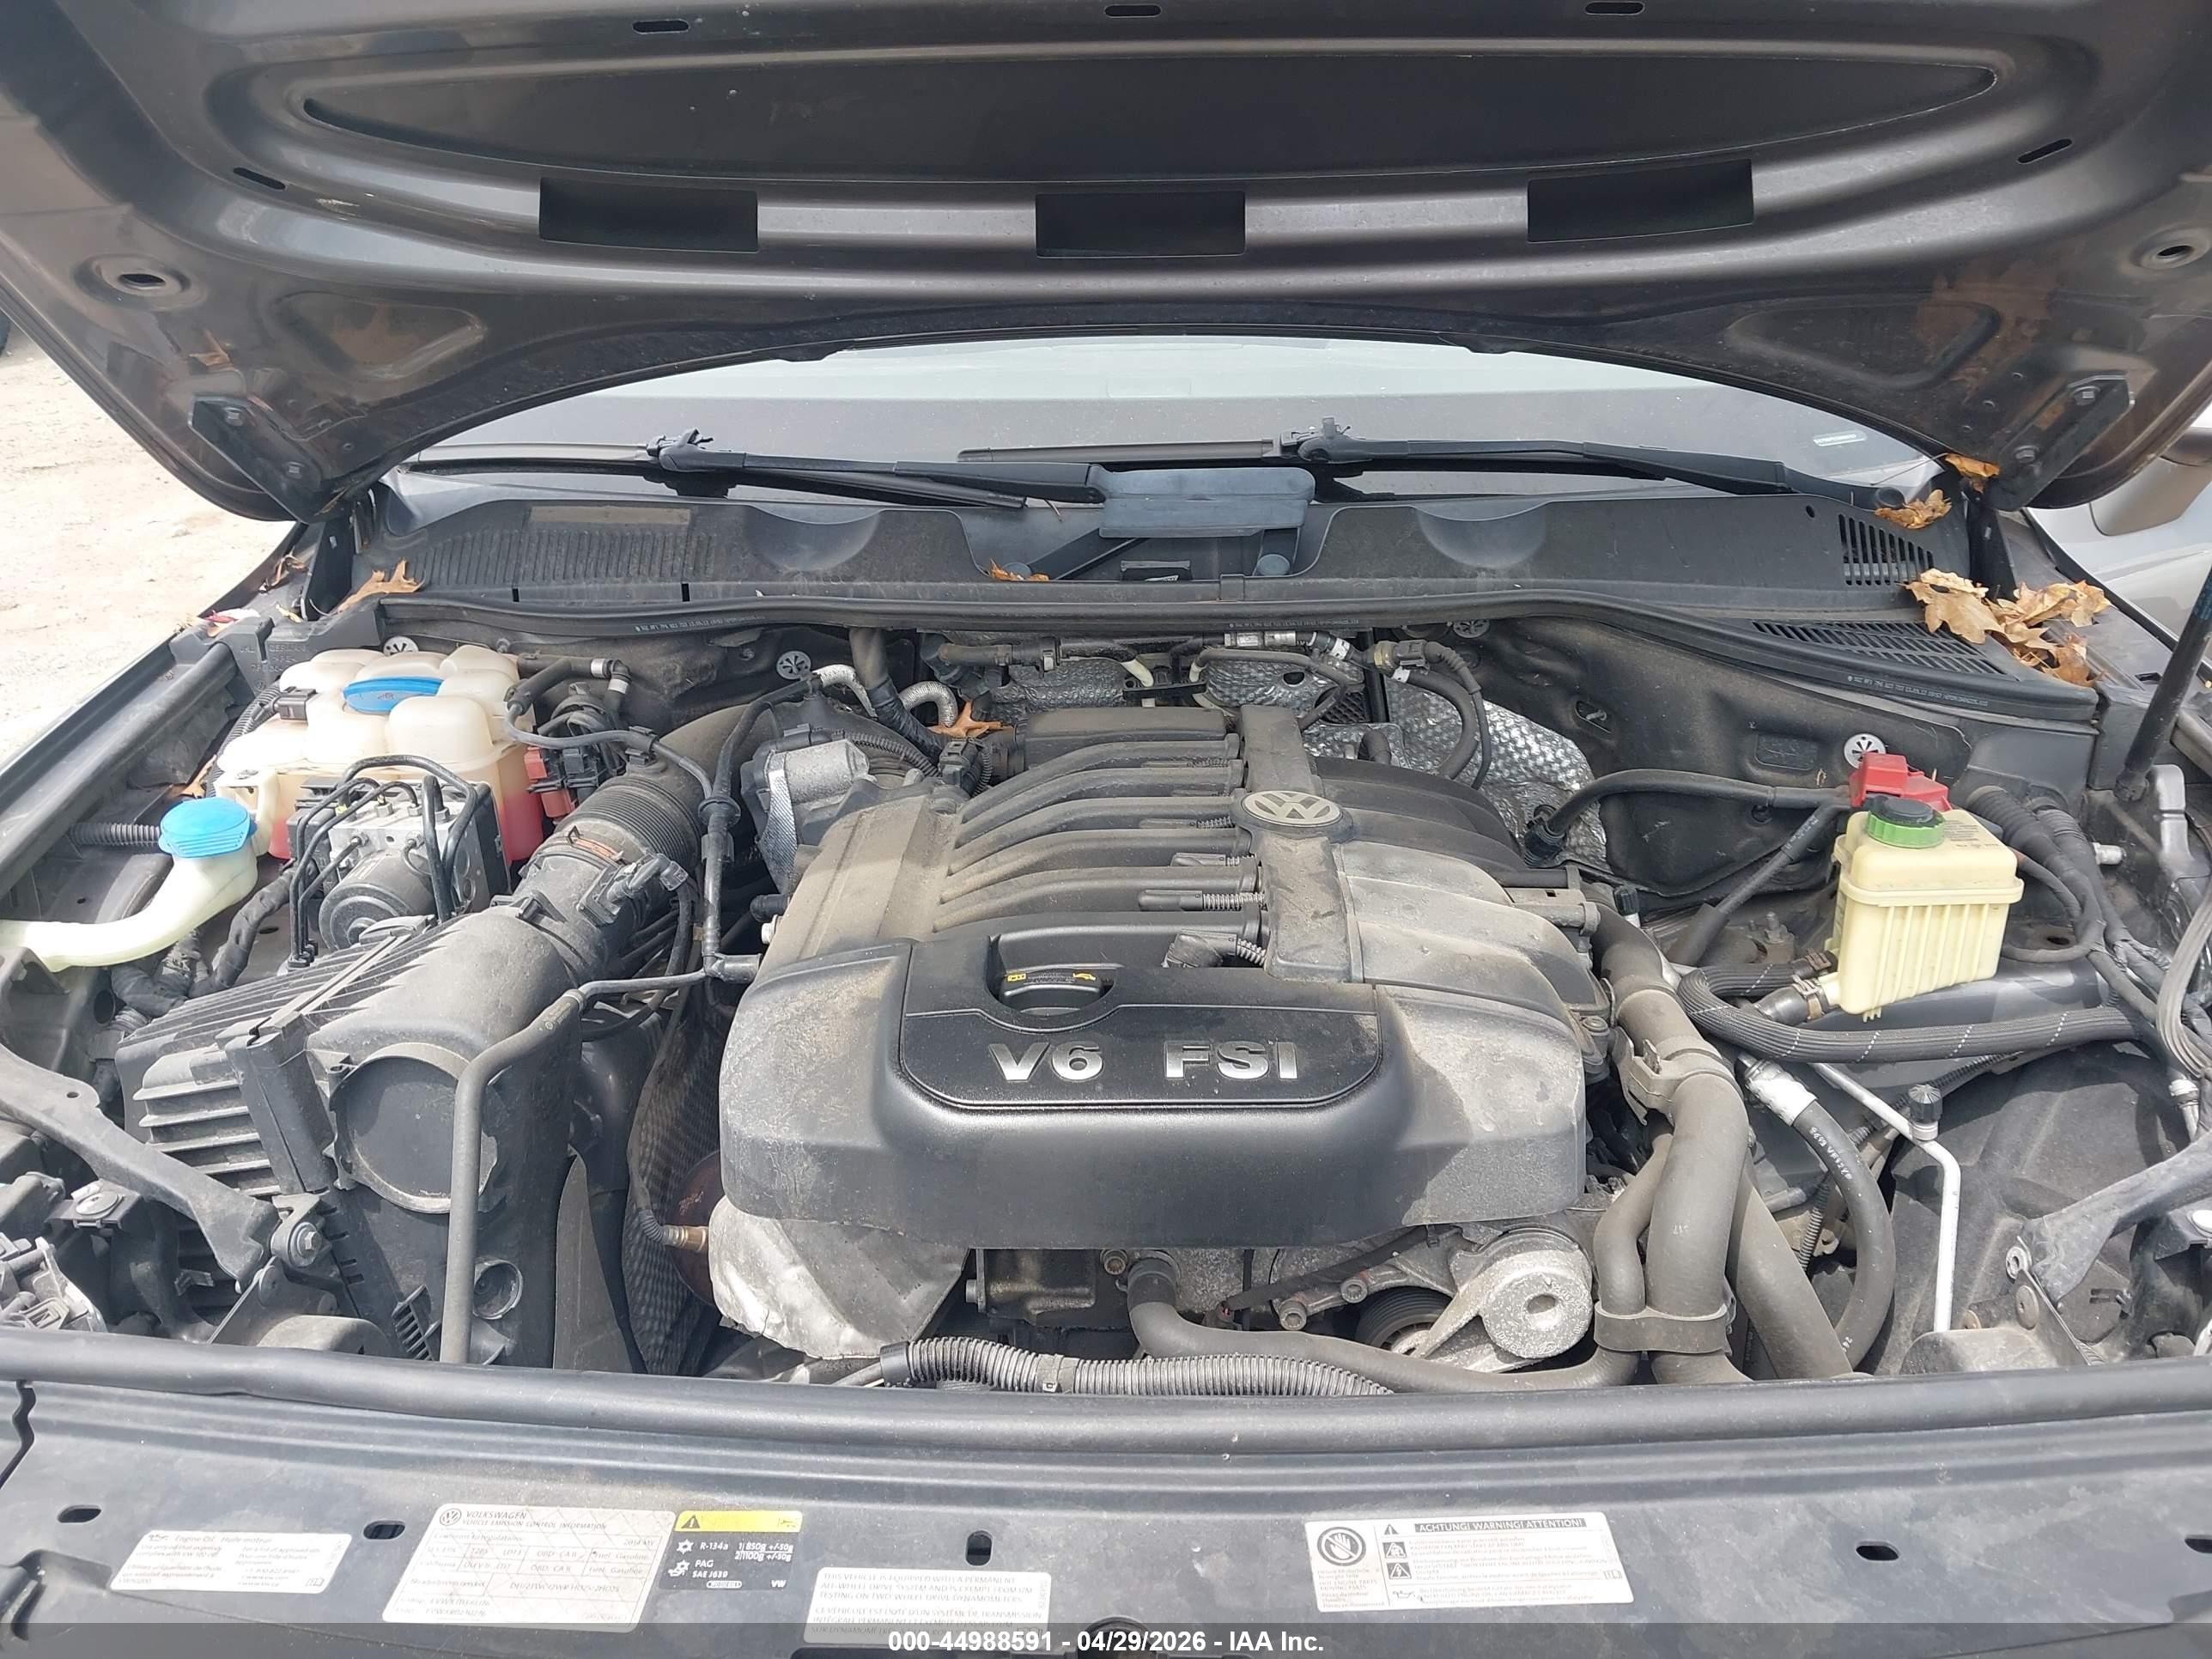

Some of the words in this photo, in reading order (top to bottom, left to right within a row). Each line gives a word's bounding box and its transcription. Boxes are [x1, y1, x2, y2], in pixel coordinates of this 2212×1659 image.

[988, 1041, 1104, 1081] V6
[1164, 1040, 1298, 1080] FSI
[465, 1510, 527, 1520] VOLKSWAGEN
[1473, 1520, 1523, 1530] WARNING!
[1526, 1517, 1583, 1528] ATTENTION!
[700, 1541, 729, 1550] R-134a
[695, 1559, 714, 1568] PAG
[771, 1579, 786, 1588] VW
